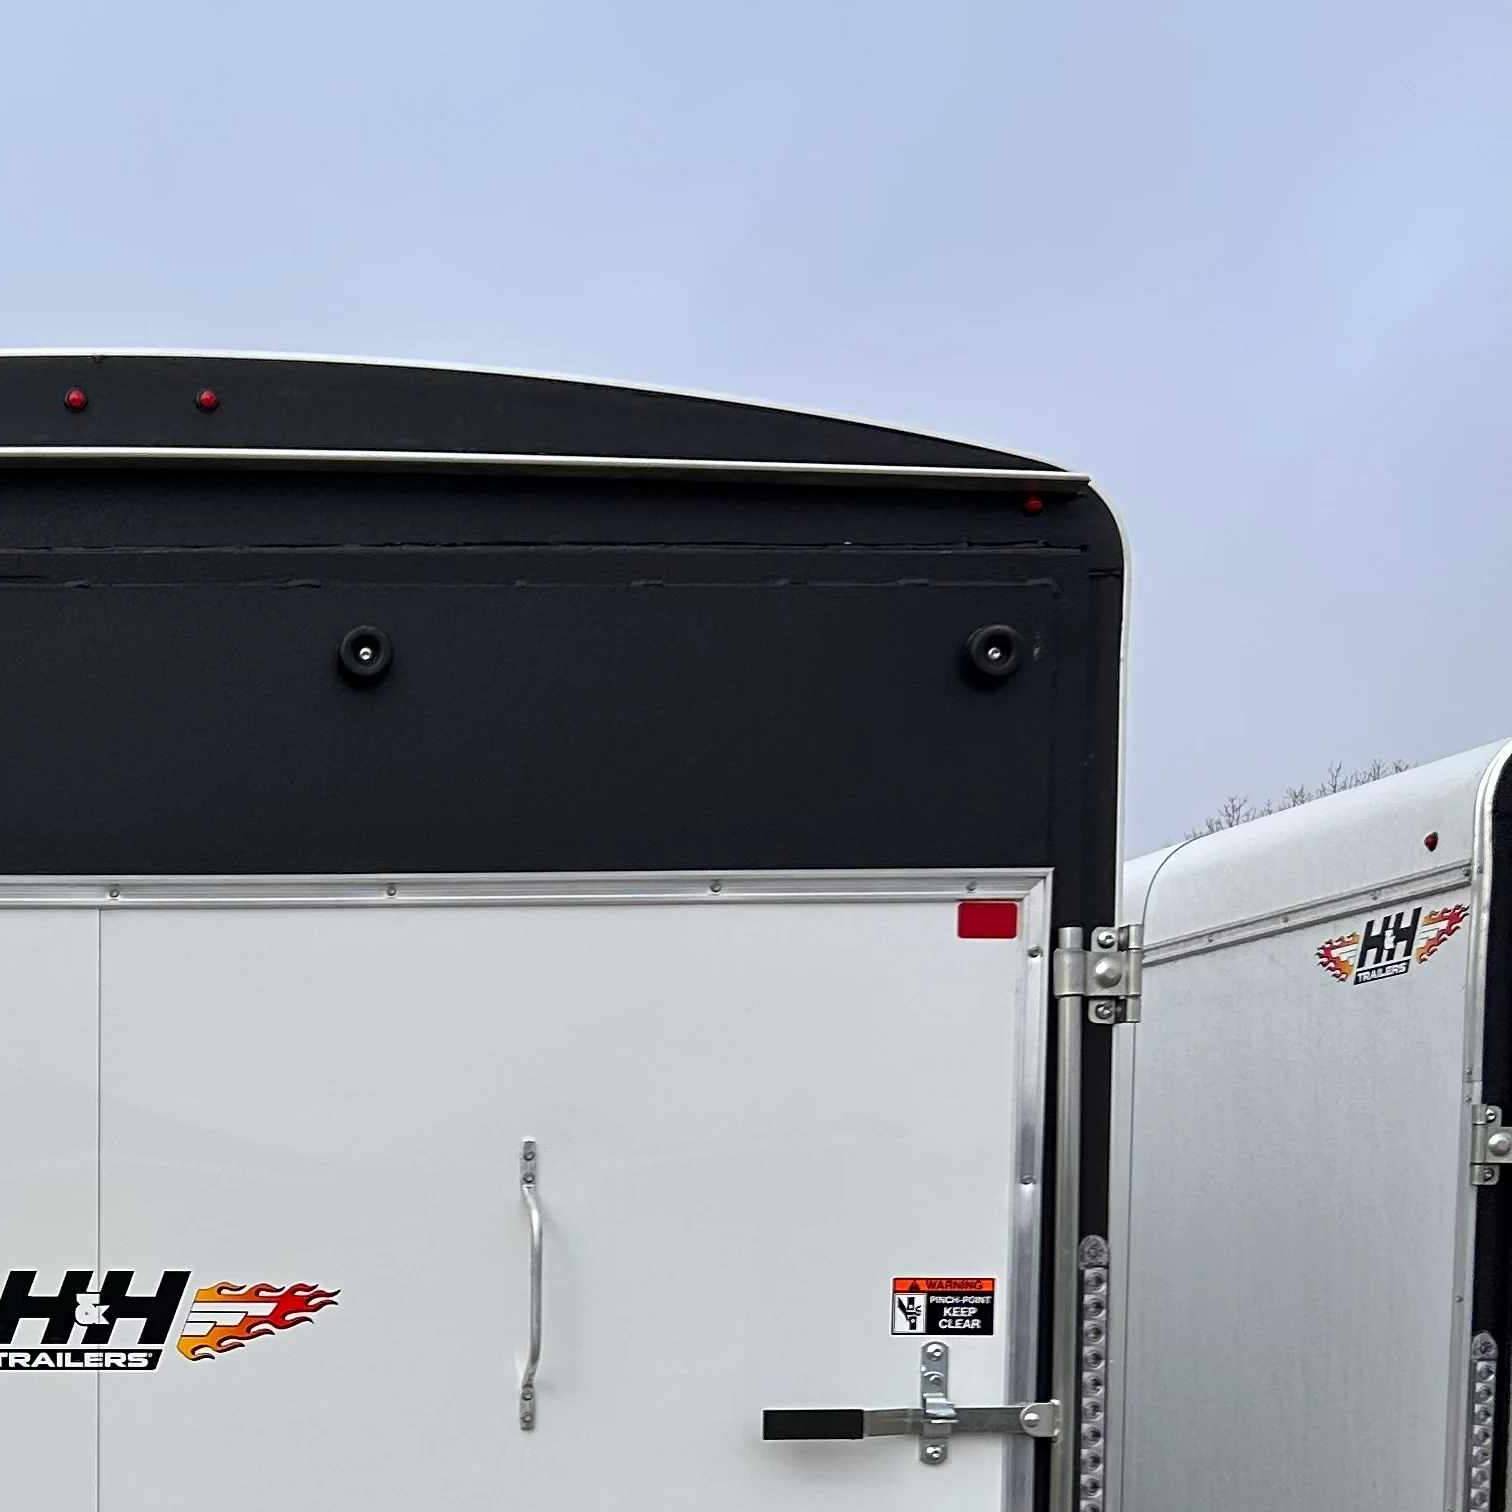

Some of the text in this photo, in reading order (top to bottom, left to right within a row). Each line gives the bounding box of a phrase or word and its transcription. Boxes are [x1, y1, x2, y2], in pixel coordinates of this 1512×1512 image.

[1357, 907, 1422, 968] H&H
[1356, 963, 1407, 983] TRAILERS
[926, 1280, 983, 1289] WARNING
[943, 1307, 978, 1317] KEEP
[938, 1319, 982, 1329] CLEAR
